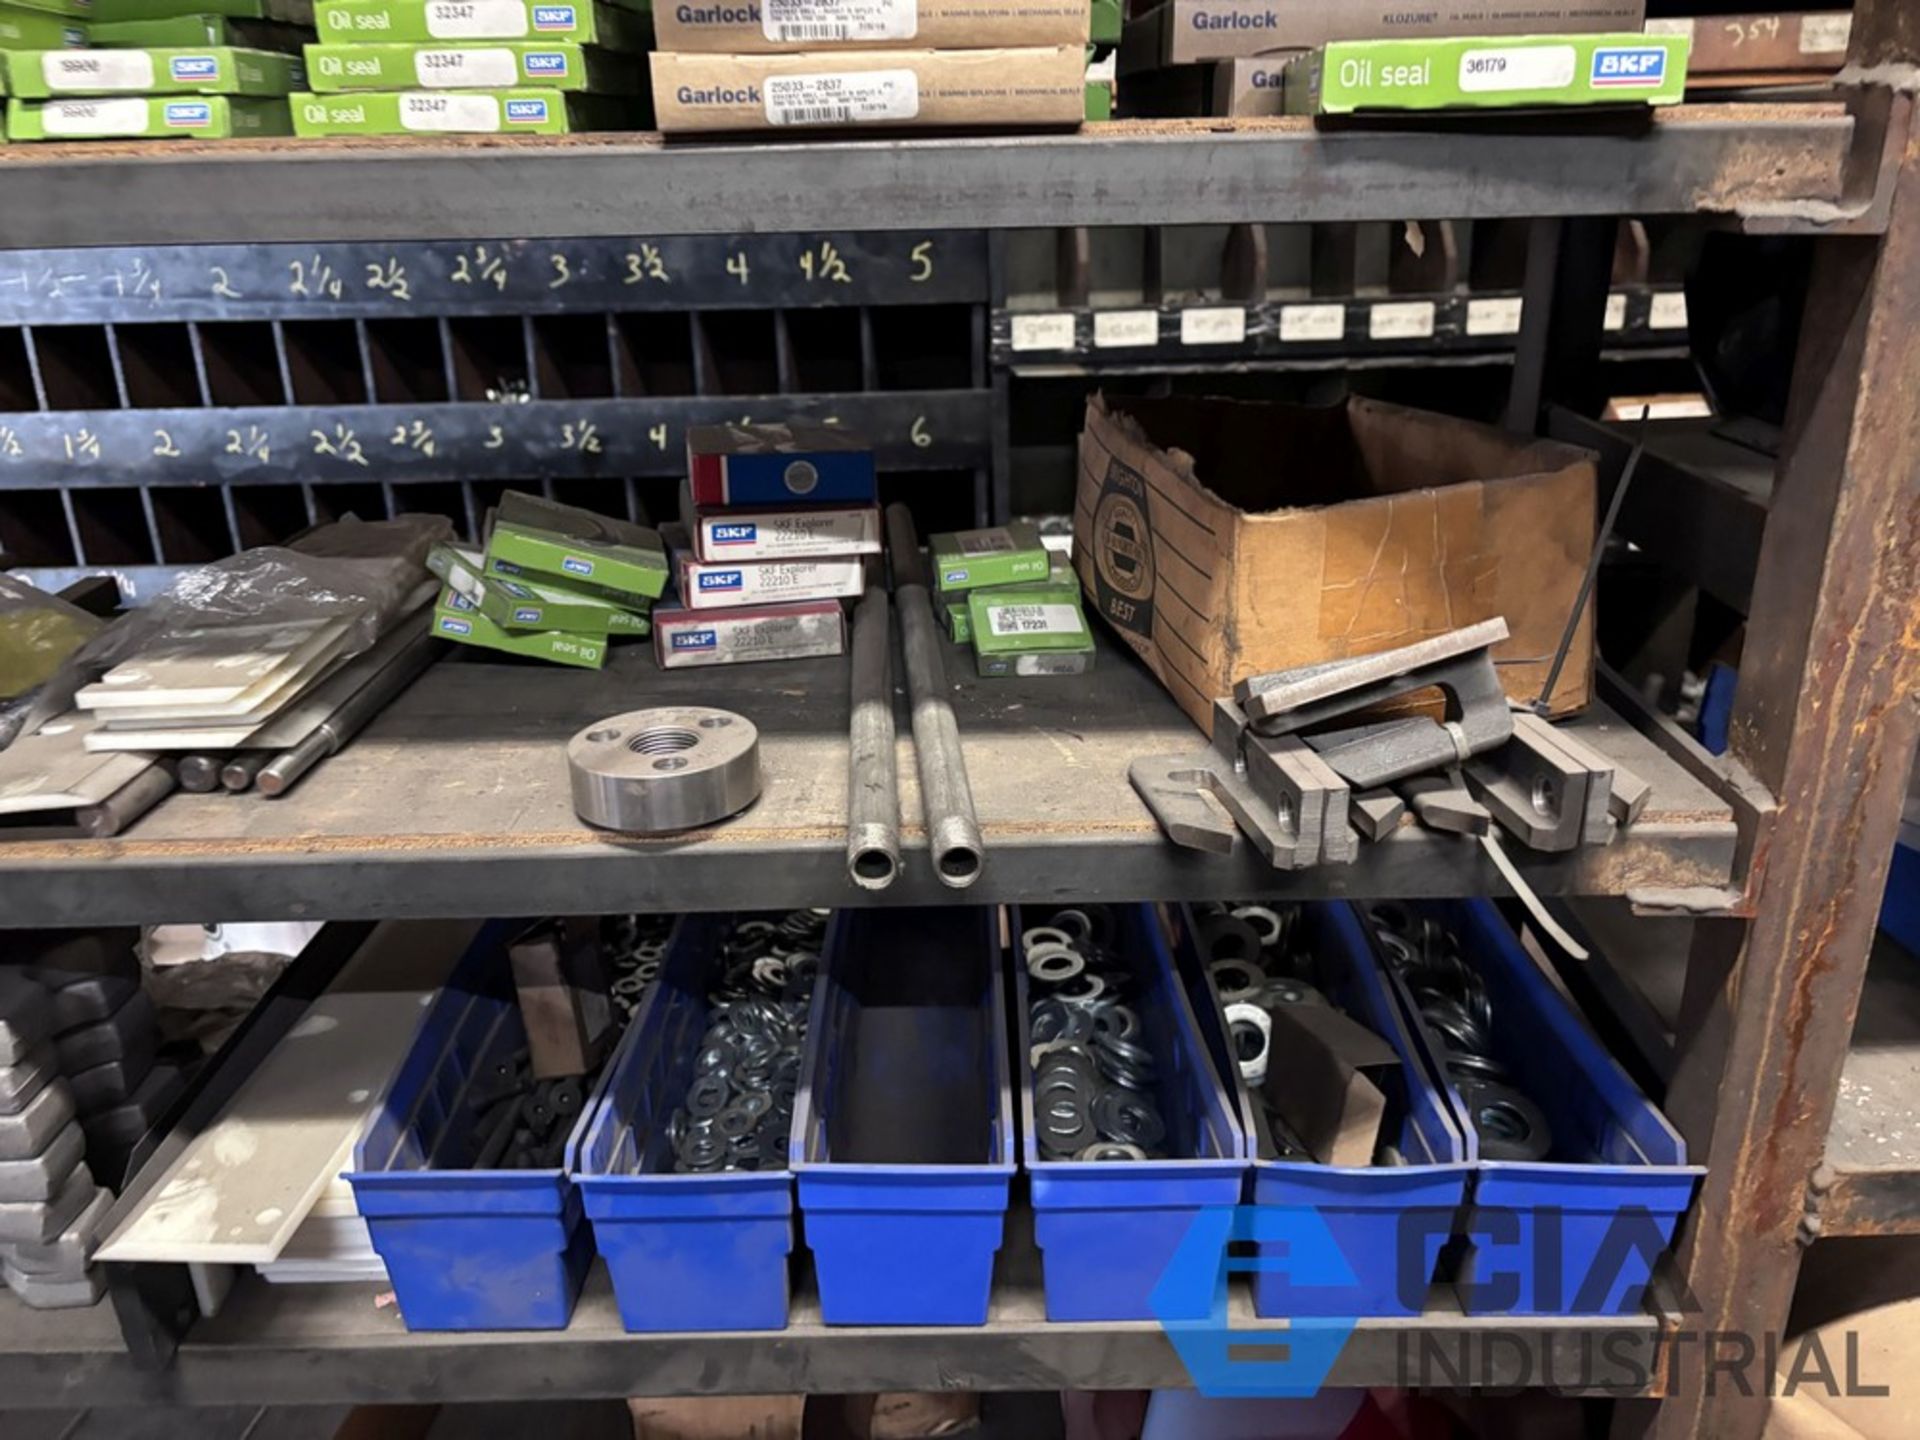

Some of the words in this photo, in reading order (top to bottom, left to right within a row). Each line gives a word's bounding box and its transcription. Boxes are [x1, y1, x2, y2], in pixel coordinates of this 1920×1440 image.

[329, 11, 351, 30] Oil
[356, 11, 390, 29] seal
[537, 9, 571, 22] SKF
[676, 5, 761, 24] Garlock
[1192, 11, 1278, 29] Garlock
[319, 57, 342, 75] Oil
[347, 57, 381, 75] seal
[425, 54, 463, 68] 32347
[527, 55, 561, 69] SKF
[1467, 58, 1507, 74] 36179
[1599, 54, 1660, 74] SKF
[1340, 59, 1371, 88] Oil
[1380, 57, 1430, 87] seal
[677, 86, 761, 104] Garlock
[304, 106, 328, 123] Oil
[332, 105, 366, 122] seal
[409, 99, 447, 112] 32347
[509, 102, 543, 116] SKF
[210, 266, 242, 298] 2
[549, 254, 570, 288] 3
[727, 252, 751, 284] 4
[910, 241, 934, 281] 5
[153, 430, 180, 457] 2
[484, 426, 504, 449] 3
[649, 423, 667, 450] 4
[910, 417, 932, 447] 6
[714, 525, 754, 541] SKF
[701, 573, 740, 587] SKF
[674, 632, 714, 646] SKF
